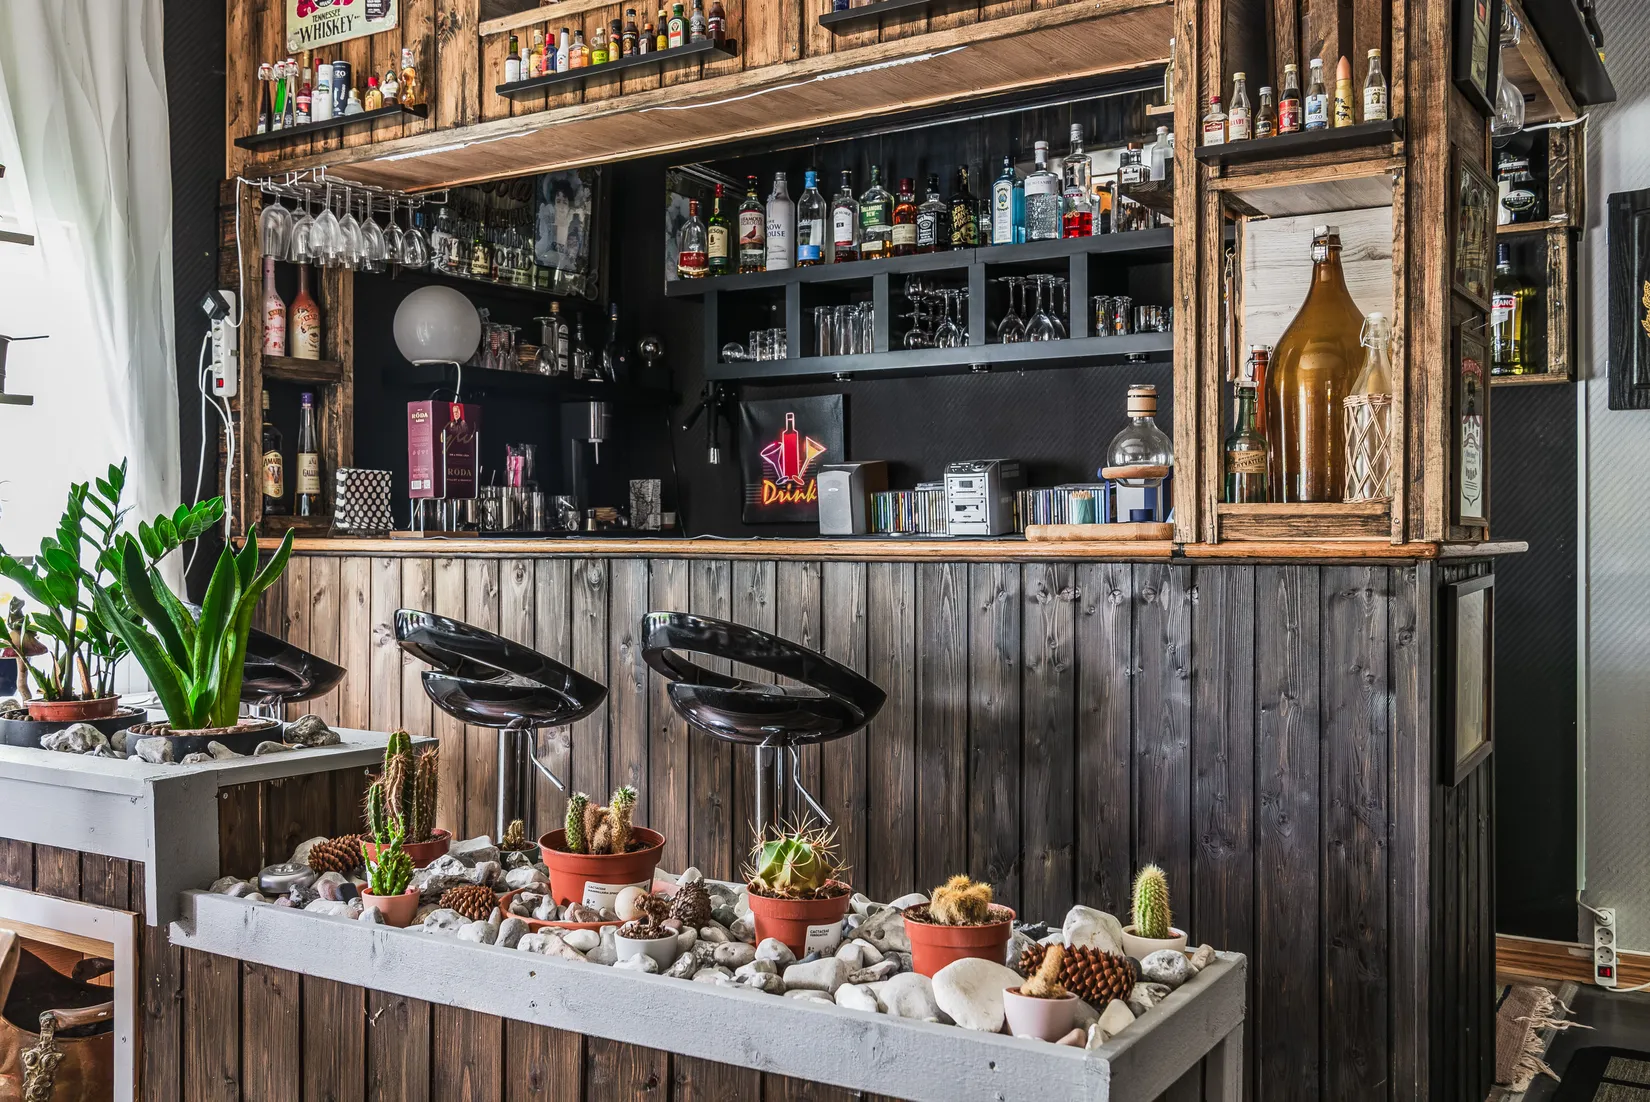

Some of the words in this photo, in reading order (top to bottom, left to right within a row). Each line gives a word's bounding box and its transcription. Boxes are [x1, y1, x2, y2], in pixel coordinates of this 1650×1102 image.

[299, 14, 355, 43] WHISKEY
[312, 9, 341, 23] TENNESSEE
[763, 479, 817, 505] Drink
